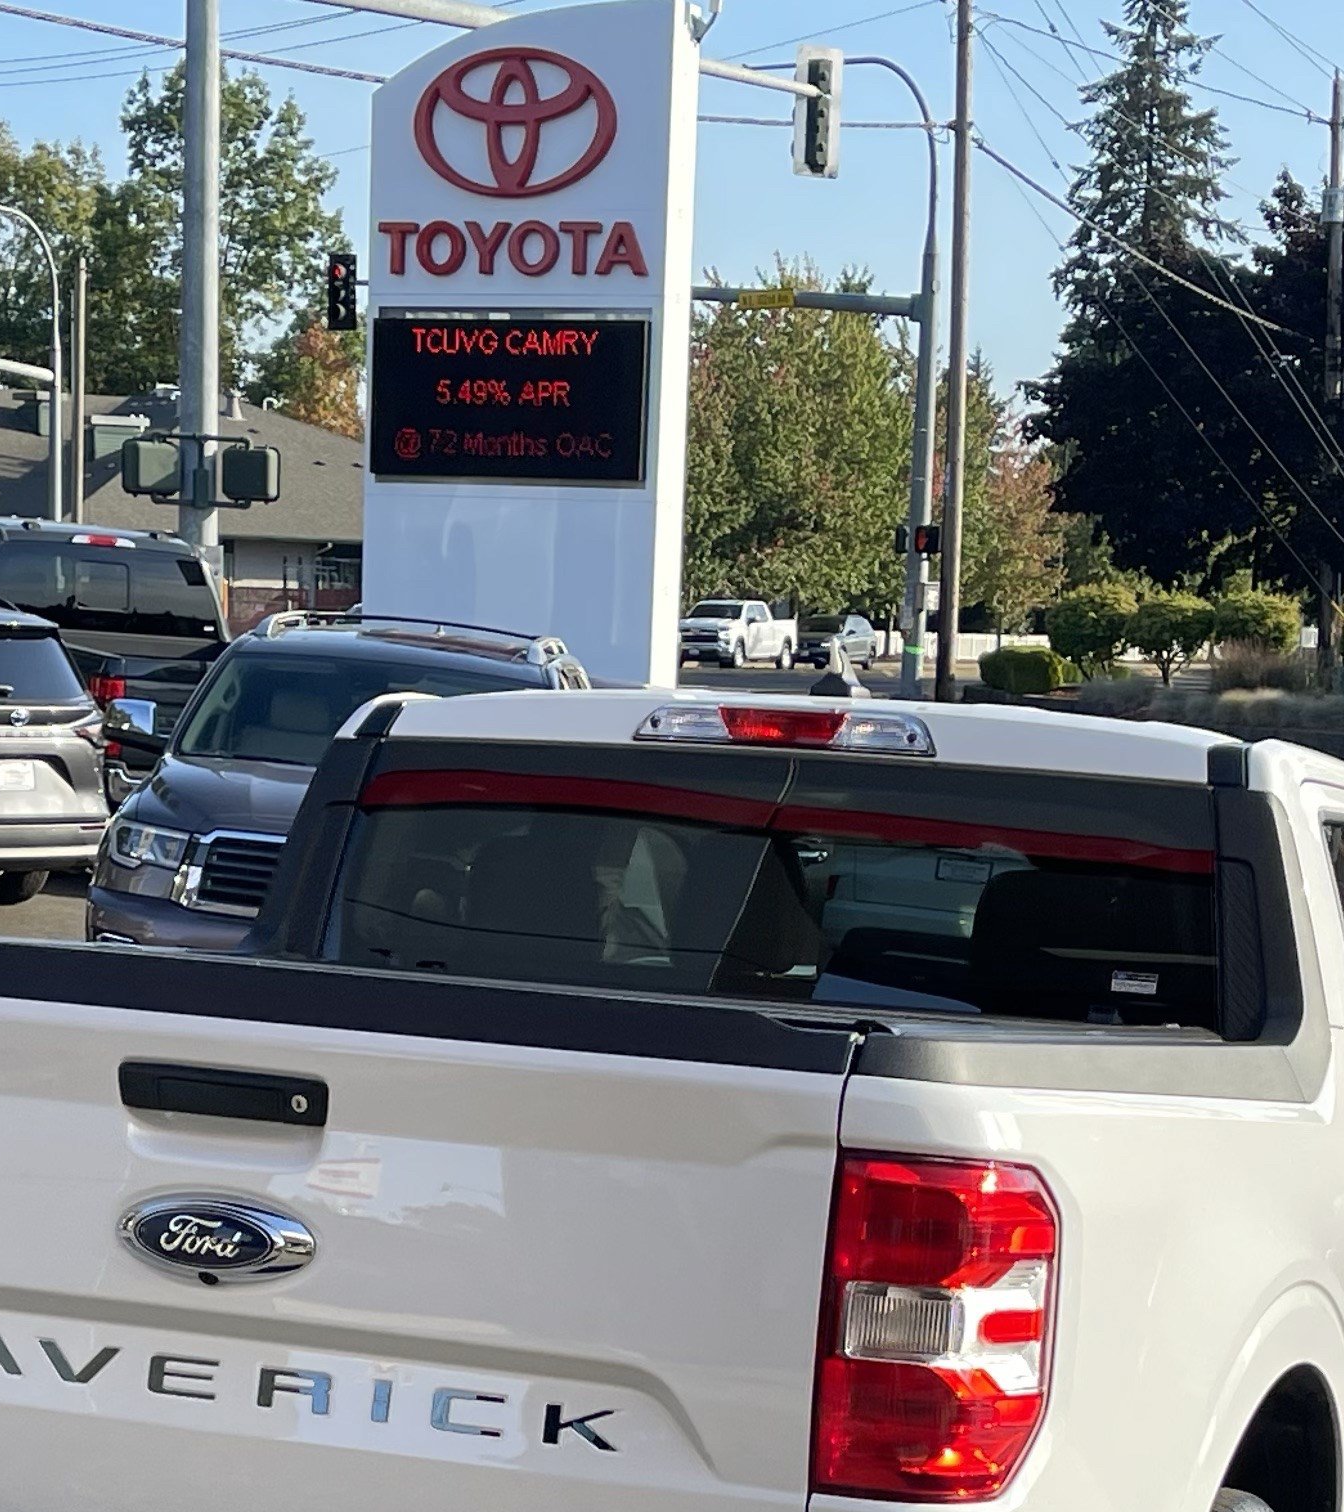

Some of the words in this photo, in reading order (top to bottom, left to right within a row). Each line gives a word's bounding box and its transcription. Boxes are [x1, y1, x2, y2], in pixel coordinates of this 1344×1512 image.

[378, 220, 649, 277] TOYOTA
[505, 329, 599, 355] CAMRY
[436, 379, 511, 406] 5.49%
[518, 381, 571, 407] APR
[428, 429, 457, 458] 72
[463, 430, 549, 458] Months
[556, 432, 613, 458] OAC
[159, 1214, 242, 1258] Ford
